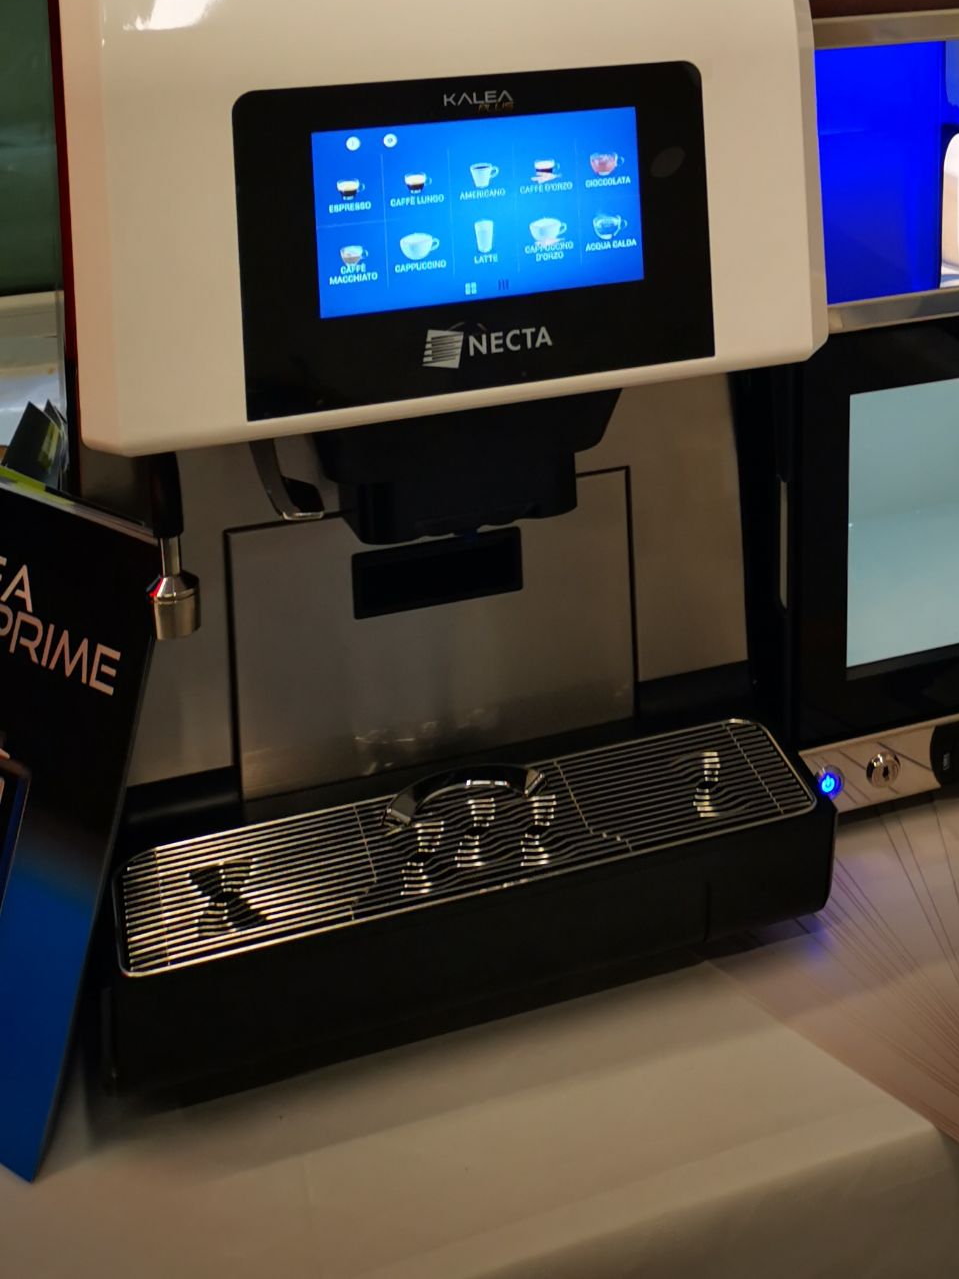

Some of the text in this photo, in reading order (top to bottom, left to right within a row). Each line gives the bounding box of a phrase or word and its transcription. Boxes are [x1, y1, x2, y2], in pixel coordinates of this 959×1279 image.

[443, 89, 514, 107] KALEA
[417, 193, 445, 205] LUNGO
[459, 187, 506, 201] AMERICANO
[328, 201, 372, 214] ESPRESSO
[473, 253, 499, 265] LATTE
[394, 259, 447, 274] CAPPUCCINO
[329, 271, 379, 286] MACCHIATO
[468, 326, 553, 357] NECTA
